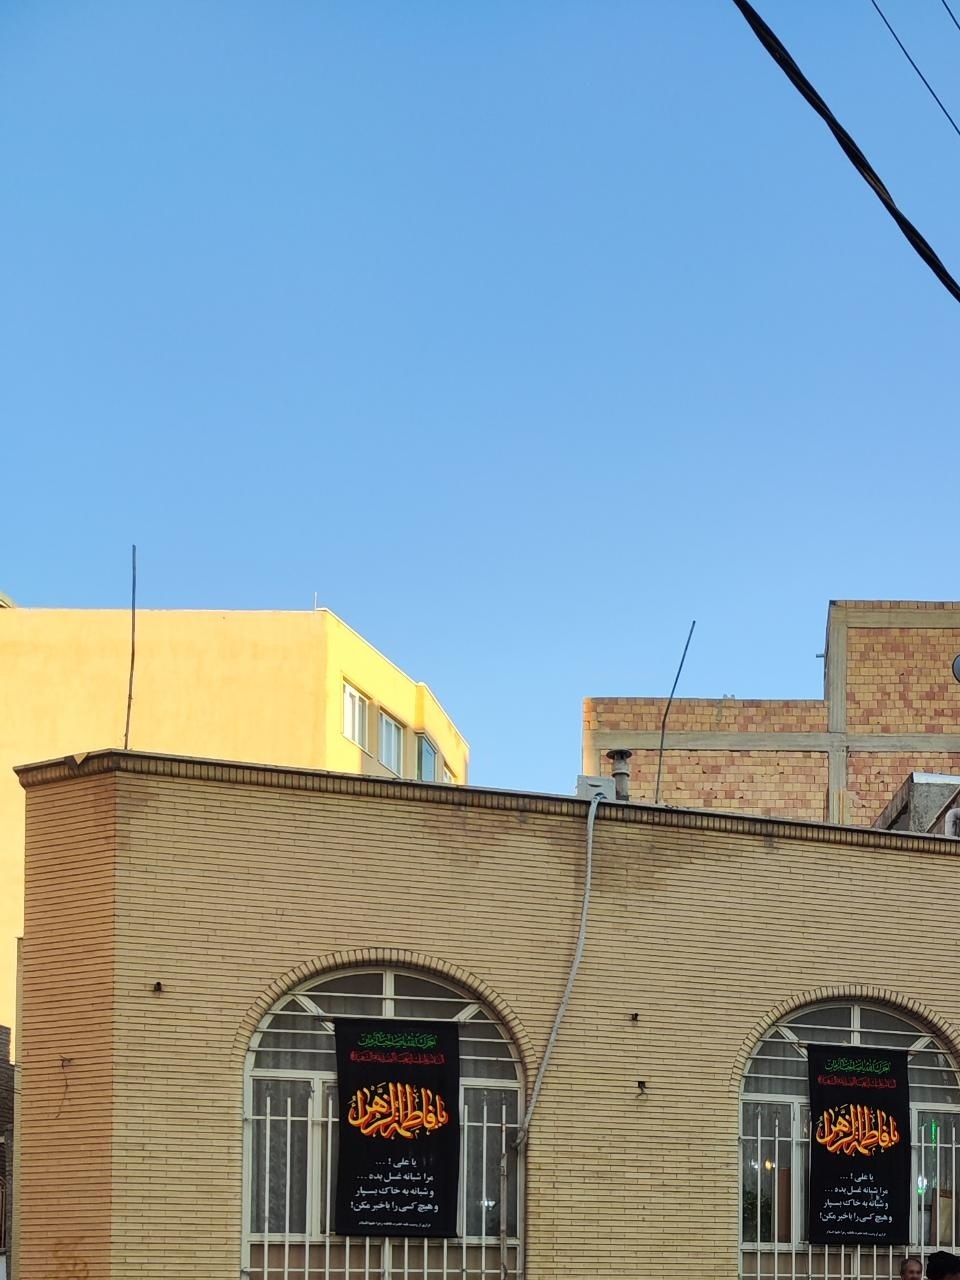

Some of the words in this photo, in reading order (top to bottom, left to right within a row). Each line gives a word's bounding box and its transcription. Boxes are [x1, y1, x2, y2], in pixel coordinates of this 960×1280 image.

[393, 1157, 410, 1168] علی
[411, 1157, 417, 1168] یا
[368, 1173, 383, 1182] بده
[403, 1172, 422, 1183] شبانه
[424, 1172, 434, 1184] مرا
[854, 1172, 868, 1183] علی
[869, 1174, 874, 1182] یا
[379, 1186, 401, 1195] خاک
[402, 1187, 410, 1197] به
[863, 1186, 879, 1195] شبانه
[880, 1187, 889, 1197] مرا
[392, 1201, 399, 1212] را
[399, 1201, 418, 1212] کسی
[417, 1203, 433, 1213] هیچ
[854, 1213, 859, 1222] را
[859, 1212, 876, 1223] کسی
[875, 1215, 888, 1223] هیچ
